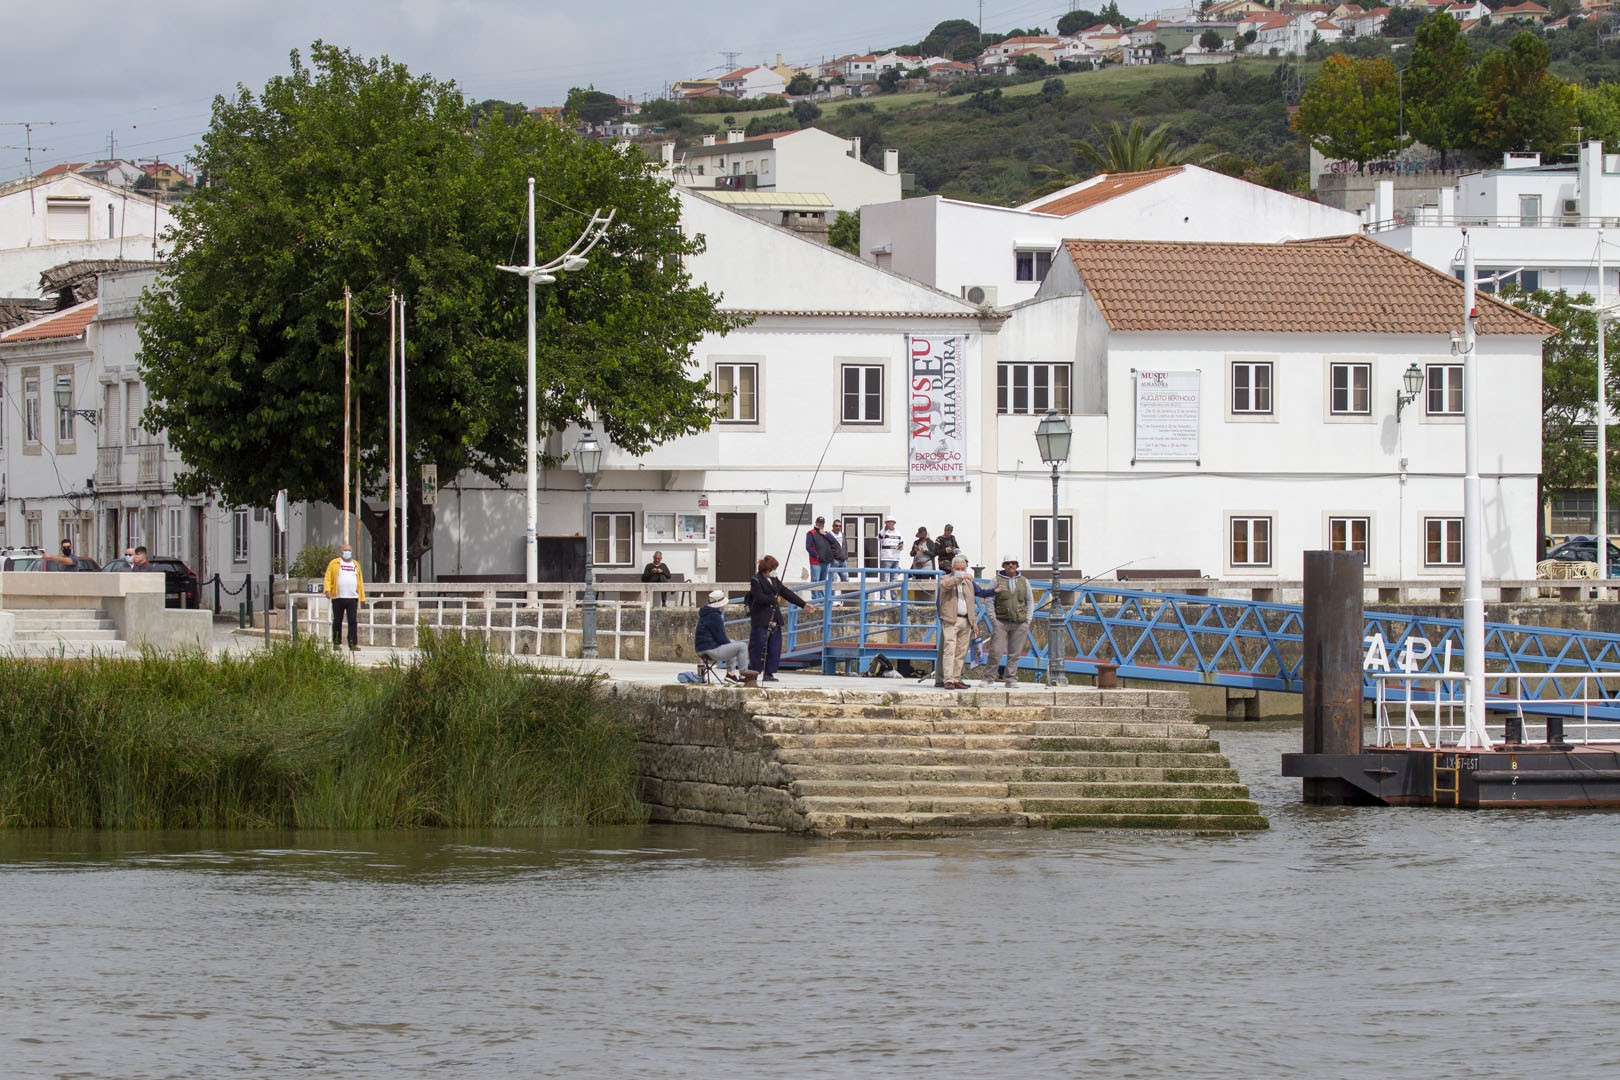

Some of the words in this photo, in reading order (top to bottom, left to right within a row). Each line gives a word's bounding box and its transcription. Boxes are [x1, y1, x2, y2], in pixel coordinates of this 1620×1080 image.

[1141, 372, 1168, 382] MUSEU
[912, 337, 943, 440] MUSEU
[944, 337, 956, 439] ALHANDRA
[915, 451, 961, 461] EXPOSIÇÃO
[911, 463, 963, 471] PERMANENTE
[1512, 761, 1518, 770] 8
